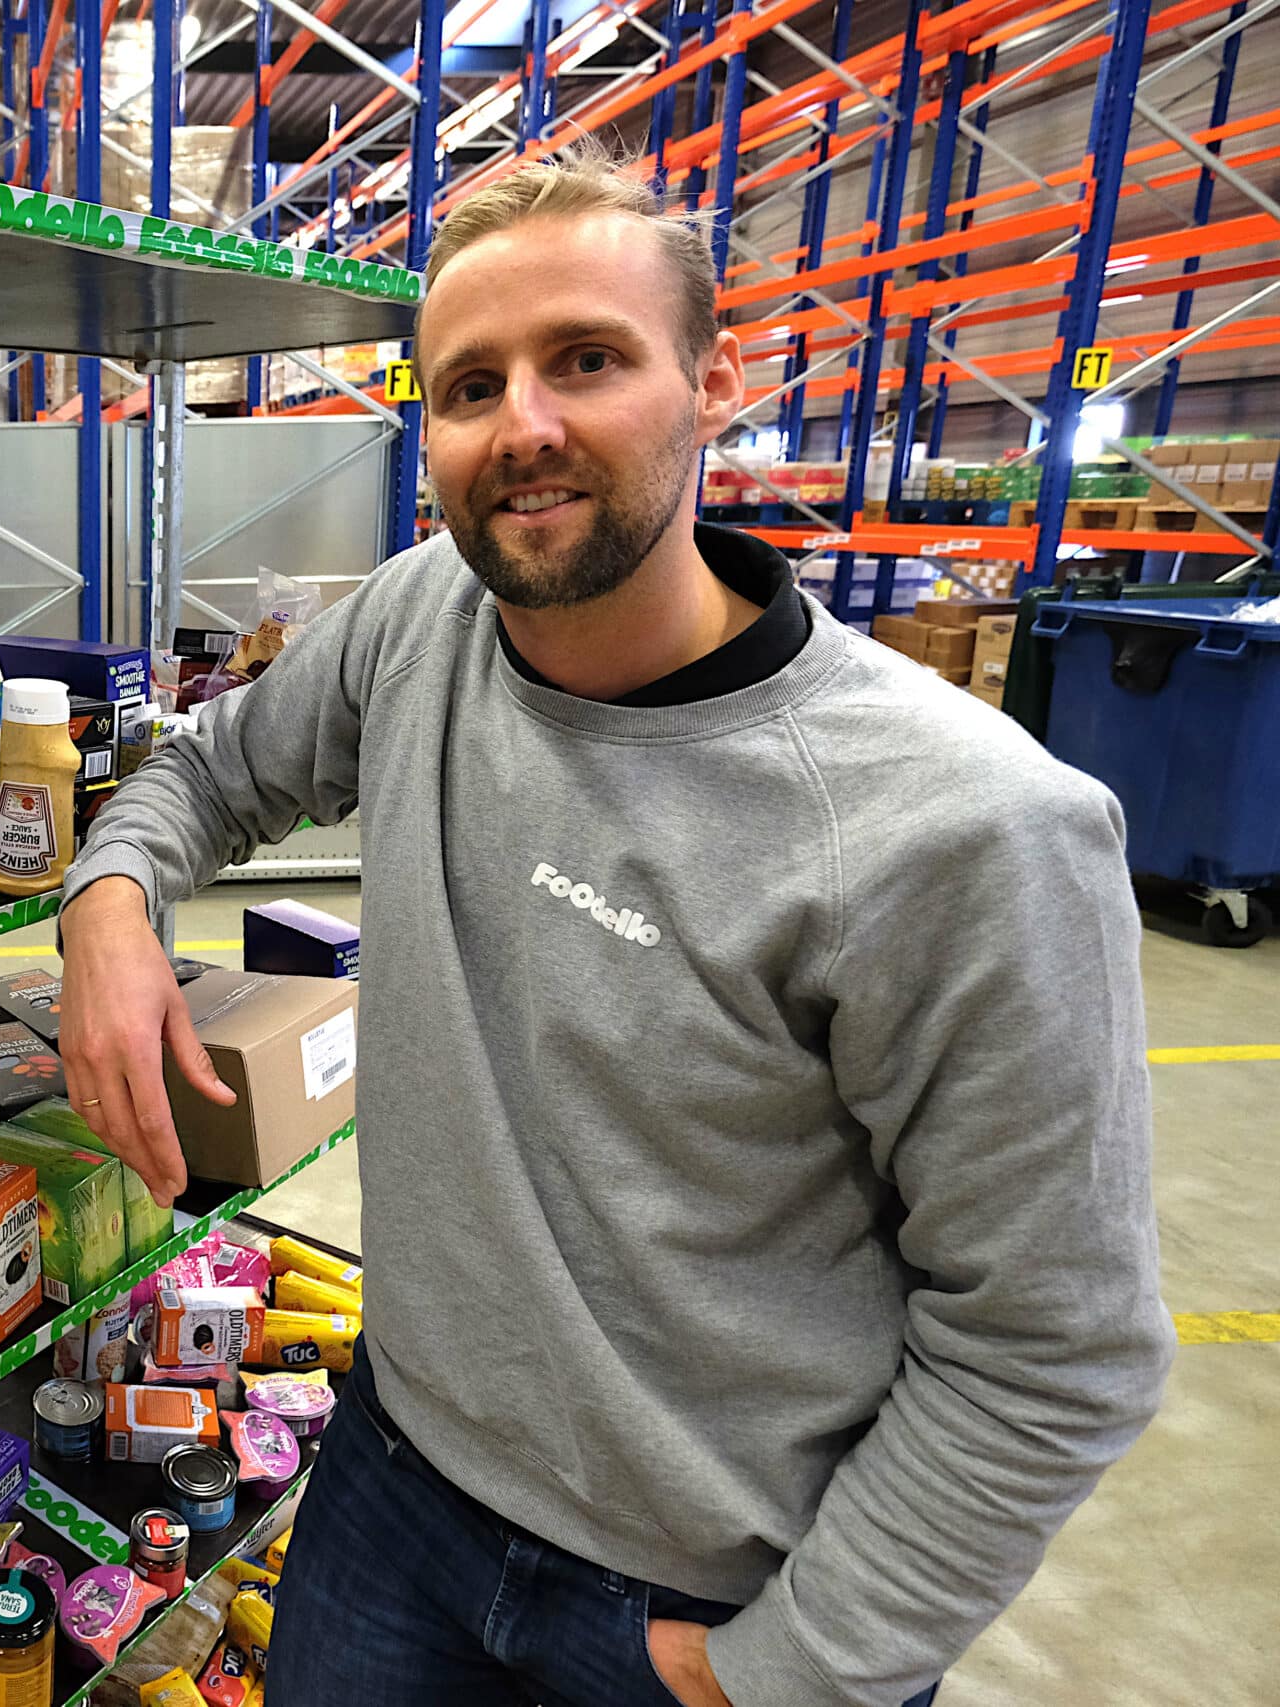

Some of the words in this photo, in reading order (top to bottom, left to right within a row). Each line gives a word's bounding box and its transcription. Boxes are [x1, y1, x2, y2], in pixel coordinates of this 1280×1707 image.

[1077, 353, 1108, 384] FT
[11, 824, 32, 833] SAUCE
[2, 830, 40, 845] BURGER
[0, 852, 39, 869] HEINZ
[225, 1309, 244, 1363] OLDTIMERS
[283, 1346, 317, 1363] TUC
[0, 1594, 22, 1606] SANA
